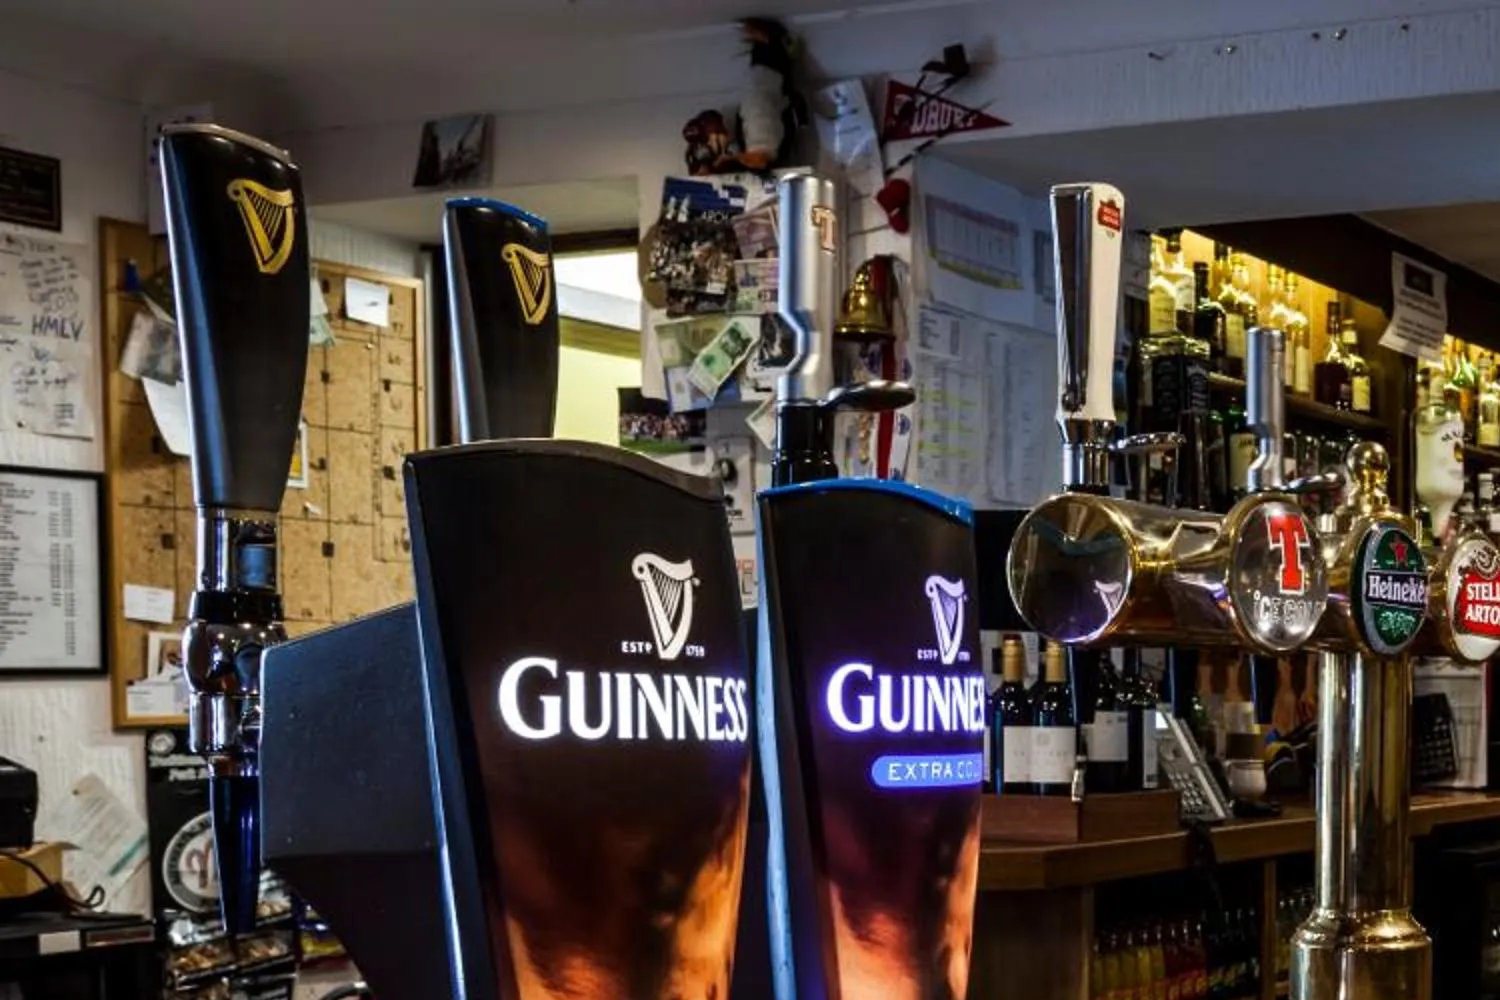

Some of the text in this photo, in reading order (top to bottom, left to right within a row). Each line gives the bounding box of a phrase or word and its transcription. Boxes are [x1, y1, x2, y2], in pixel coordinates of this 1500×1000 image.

[1267, 514, 1310, 595] T
[1367, 573, 1425, 605] Heineke
[498, 656, 748, 742] GUINNESS
[888, 763, 953, 781] EXTRA
